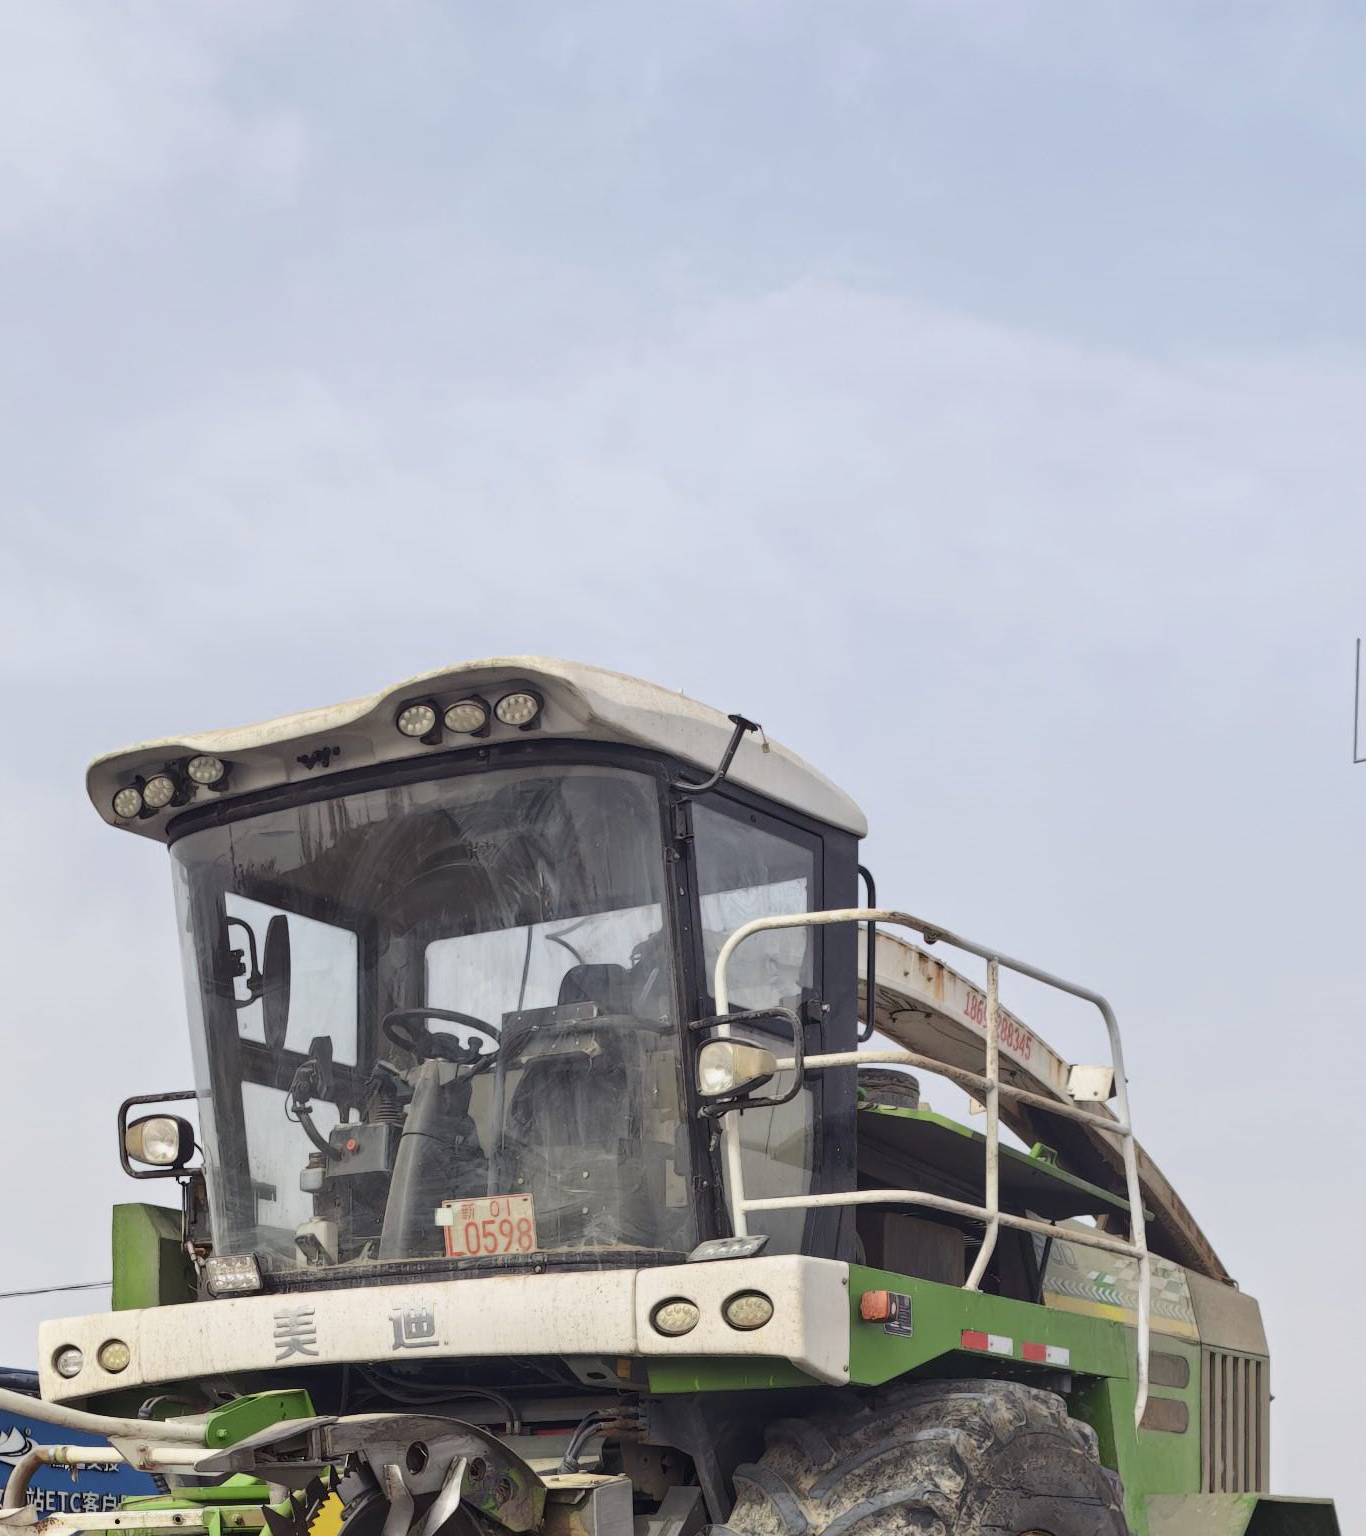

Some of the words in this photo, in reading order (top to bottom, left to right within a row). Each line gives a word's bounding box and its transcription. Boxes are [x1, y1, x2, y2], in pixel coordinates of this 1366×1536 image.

[964, 991, 1032, 1060] 18688345
[490, 1199, 511, 1217] 01
[446, 1217, 533, 1256] L0598
